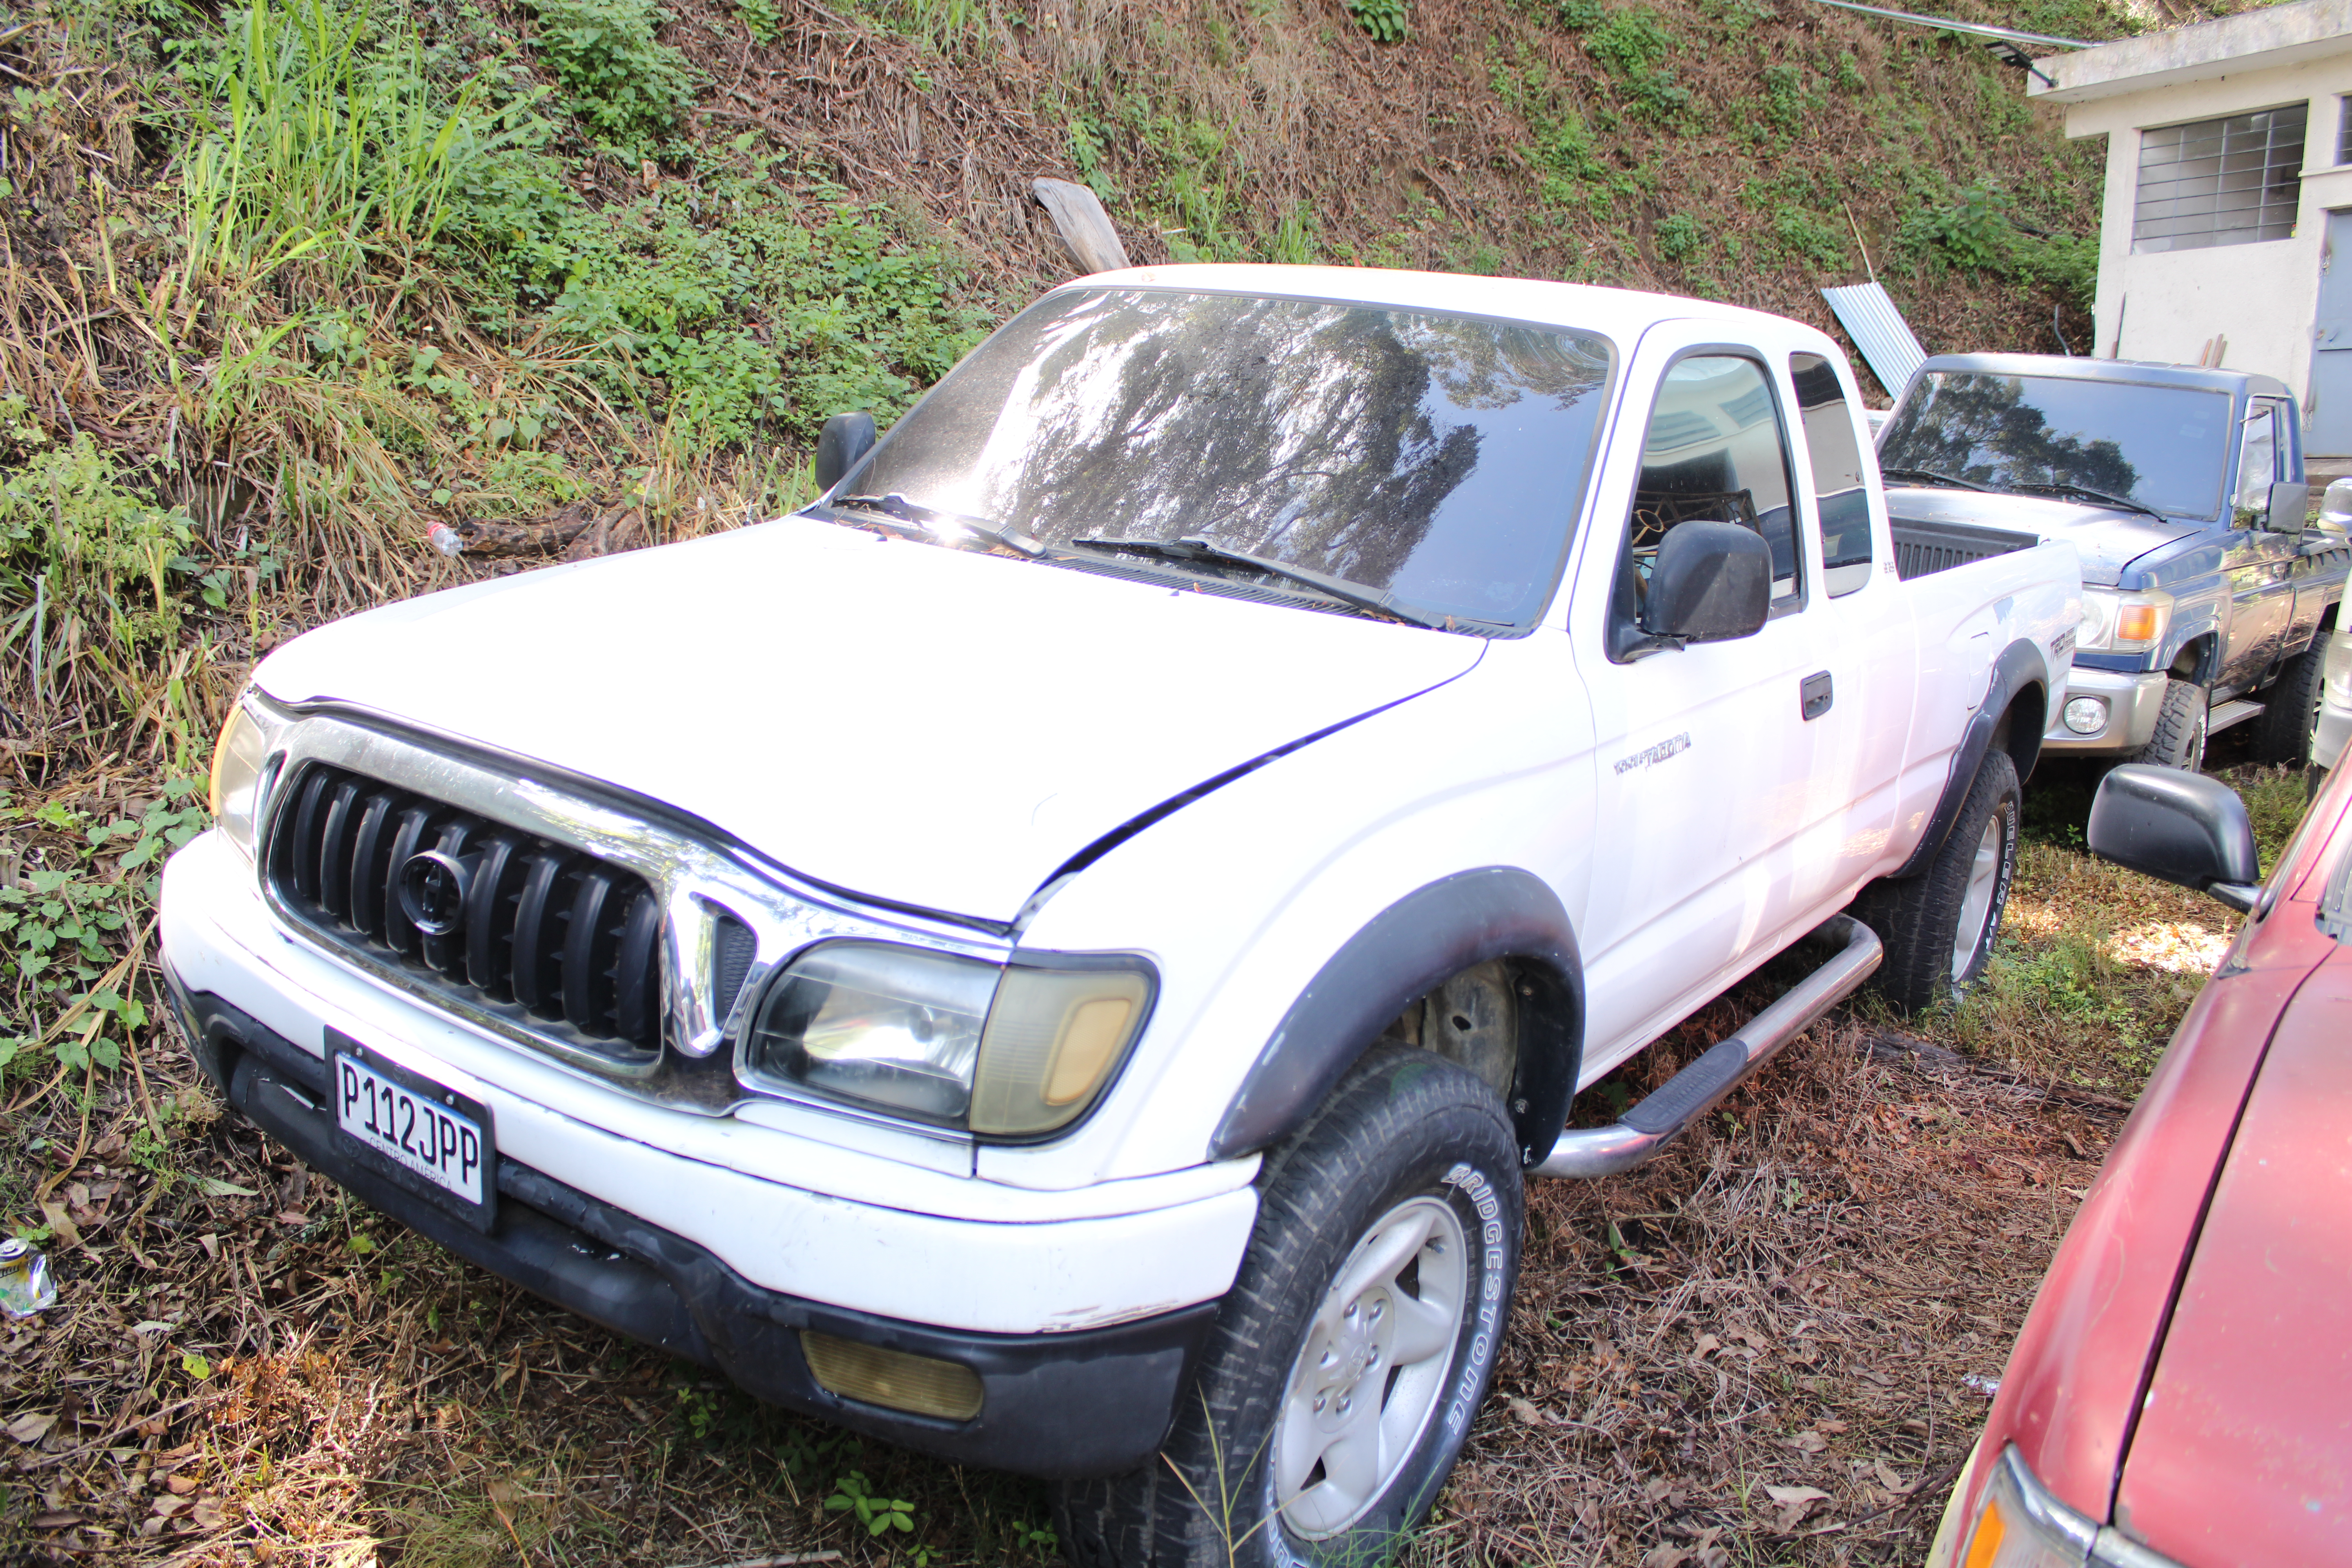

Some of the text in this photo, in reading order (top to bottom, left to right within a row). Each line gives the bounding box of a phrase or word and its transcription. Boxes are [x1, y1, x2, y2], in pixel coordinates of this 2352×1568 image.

[2049, 632, 2065, 664] TRD
[1985, 800, 2016, 950] DUELER A/T
[342, 1062, 478, 1185] P112JPP
[369, 1137, 407, 1167] CENTRO
[1441, 1163, 1503, 1436] BRIDGESTONE
